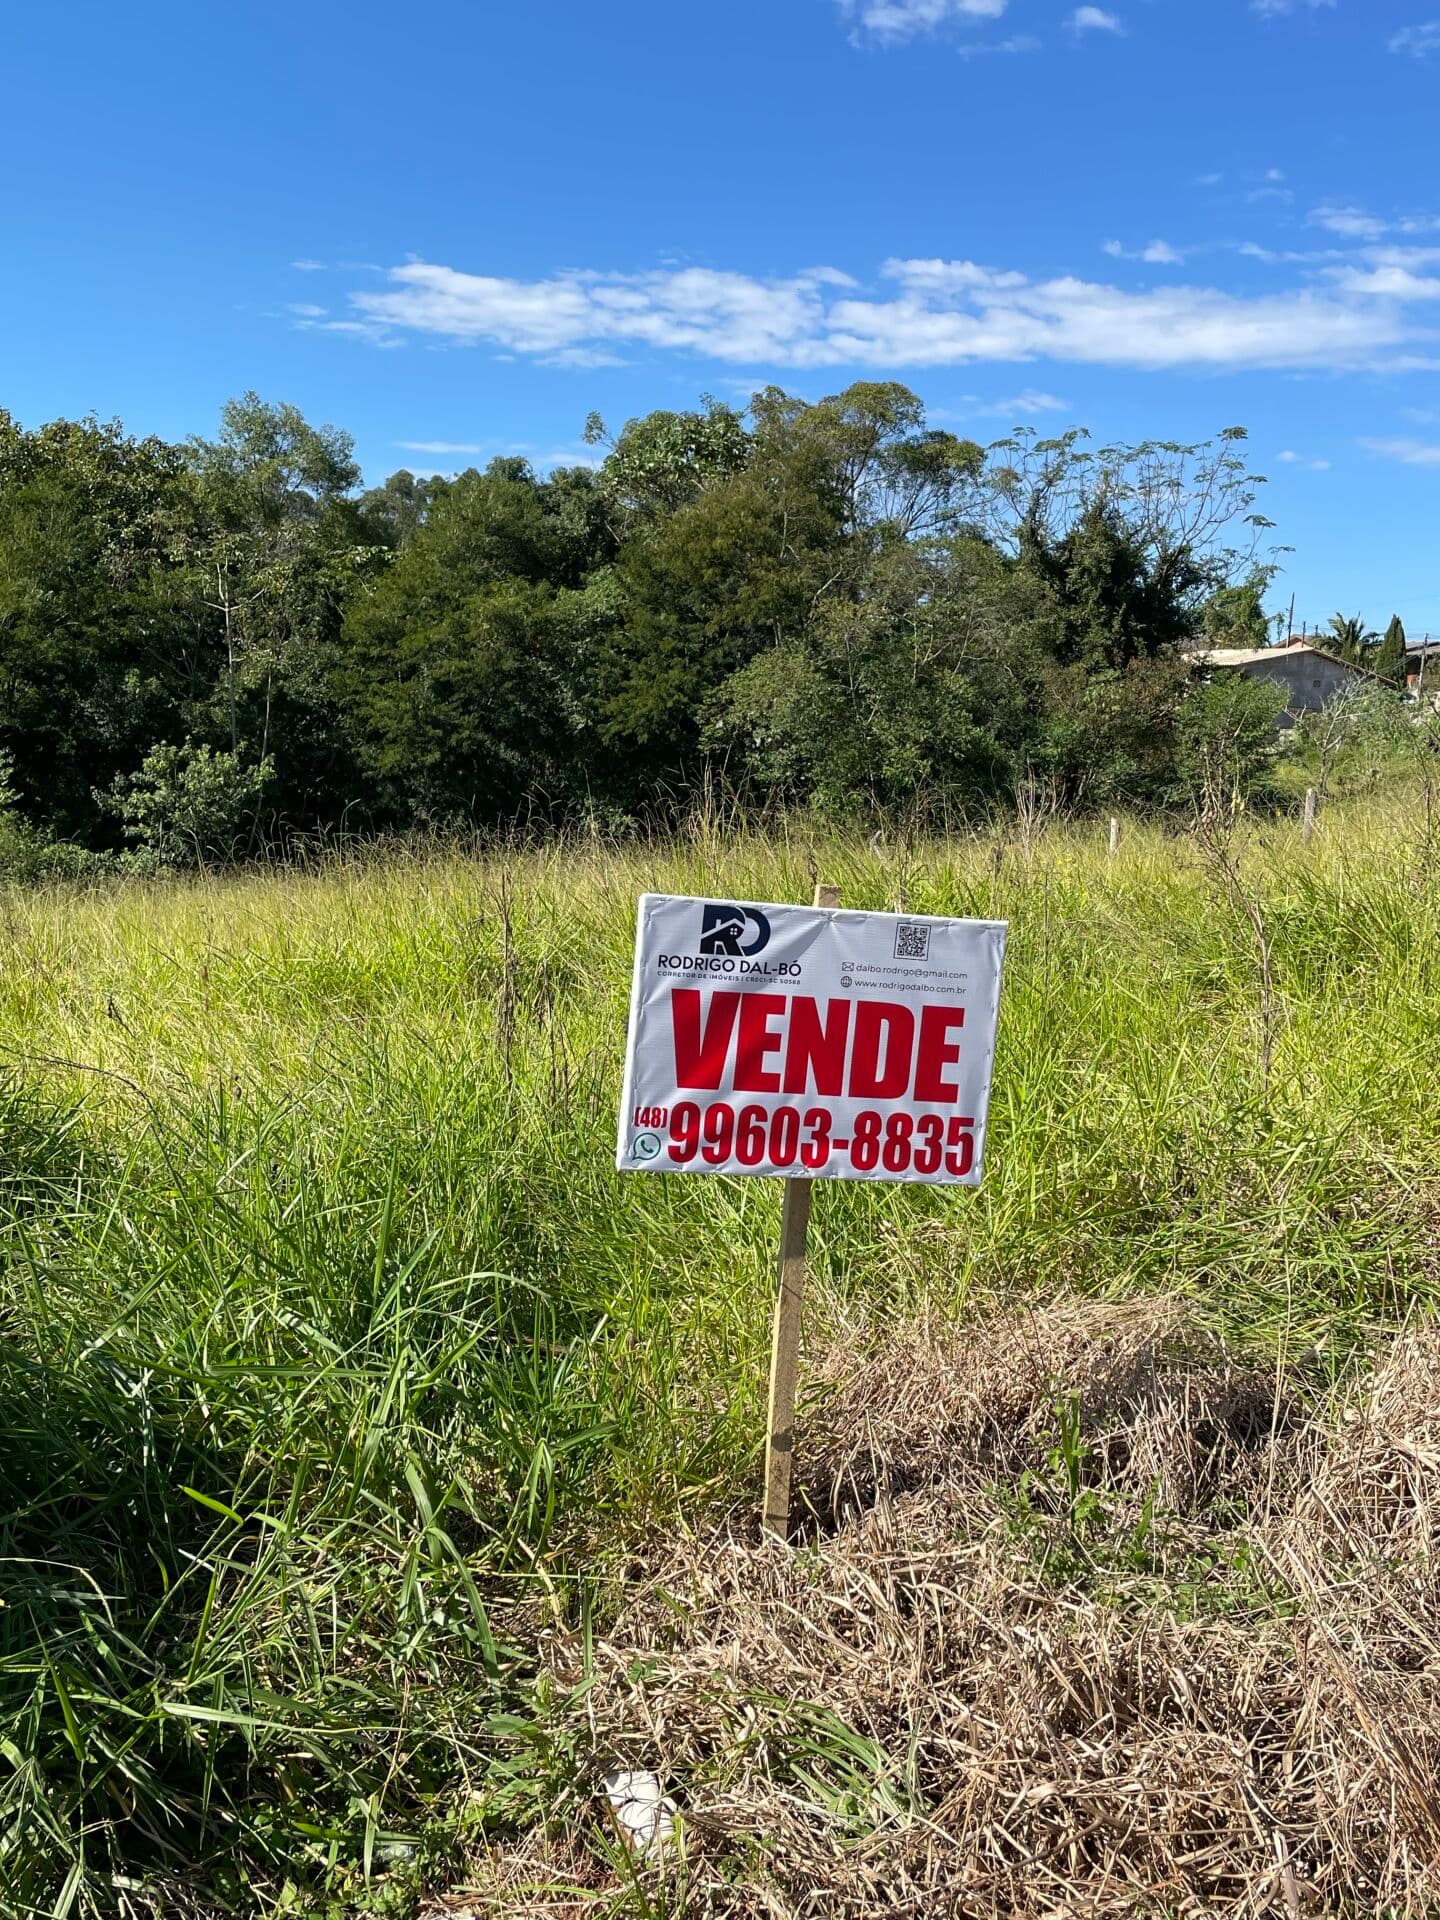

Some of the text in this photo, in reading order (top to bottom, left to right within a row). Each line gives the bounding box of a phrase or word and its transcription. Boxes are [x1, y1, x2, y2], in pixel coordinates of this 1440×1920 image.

[658, 955, 802, 977] RODRIGO DAL-BÓ
[856, 965, 968, 979] dalbo.rodrigo@gmail.com
[657, 970, 696, 979] CORRETOR
[709, 974, 740, 982] IMÓVEIS
[854, 980, 967, 994] www.rodrigodalbo.com.br
[671, 988, 965, 1104] VENDE
[634, 1101, 974, 1176] (48) 99603-8835
